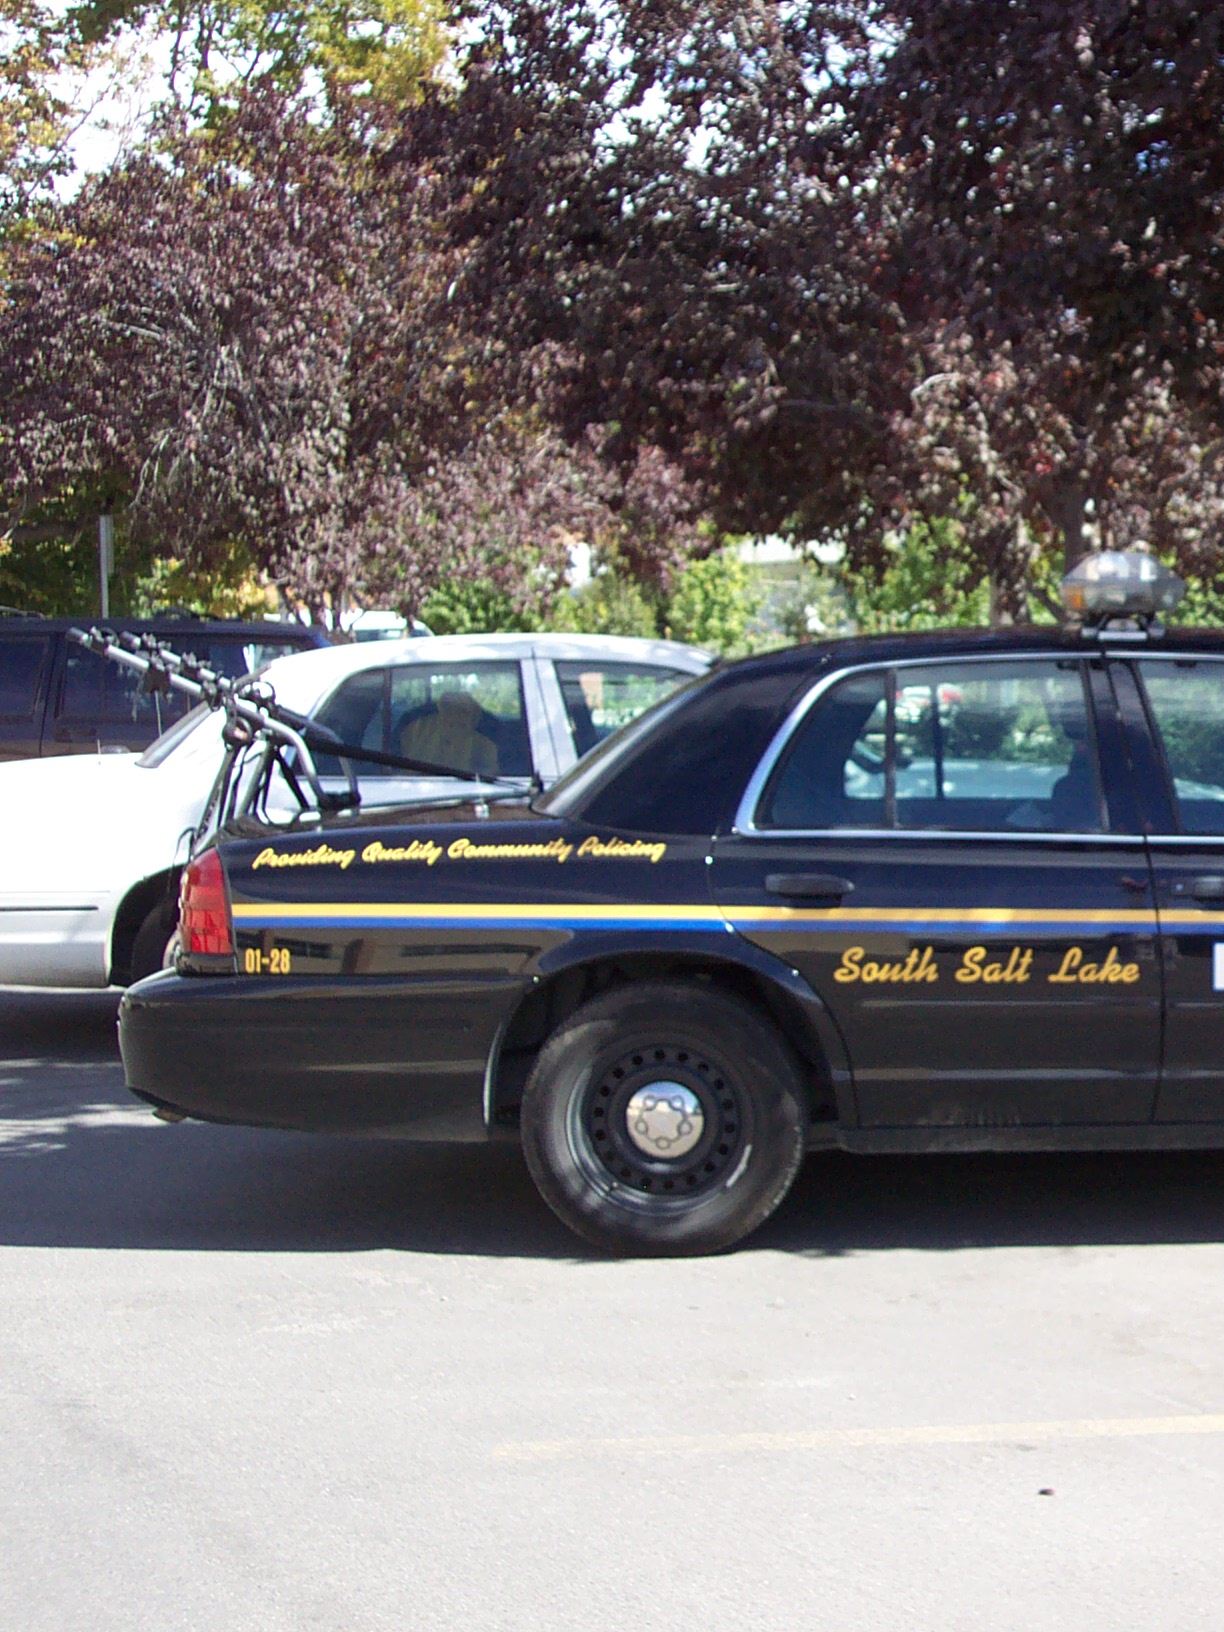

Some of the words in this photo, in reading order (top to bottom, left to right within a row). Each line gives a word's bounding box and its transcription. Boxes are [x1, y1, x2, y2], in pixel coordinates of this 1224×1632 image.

[252, 846, 355, 869] Providing
[362, 840, 443, 865] Quality
[448, 838, 573, 861] Community
[577, 836, 666, 862] Policing
[244, 948, 291, 974] 01-28
[834, 946, 938, 983] South
[955, 946, 1032, 983] Salt
[1048, 946, 1140, 983] Lake
